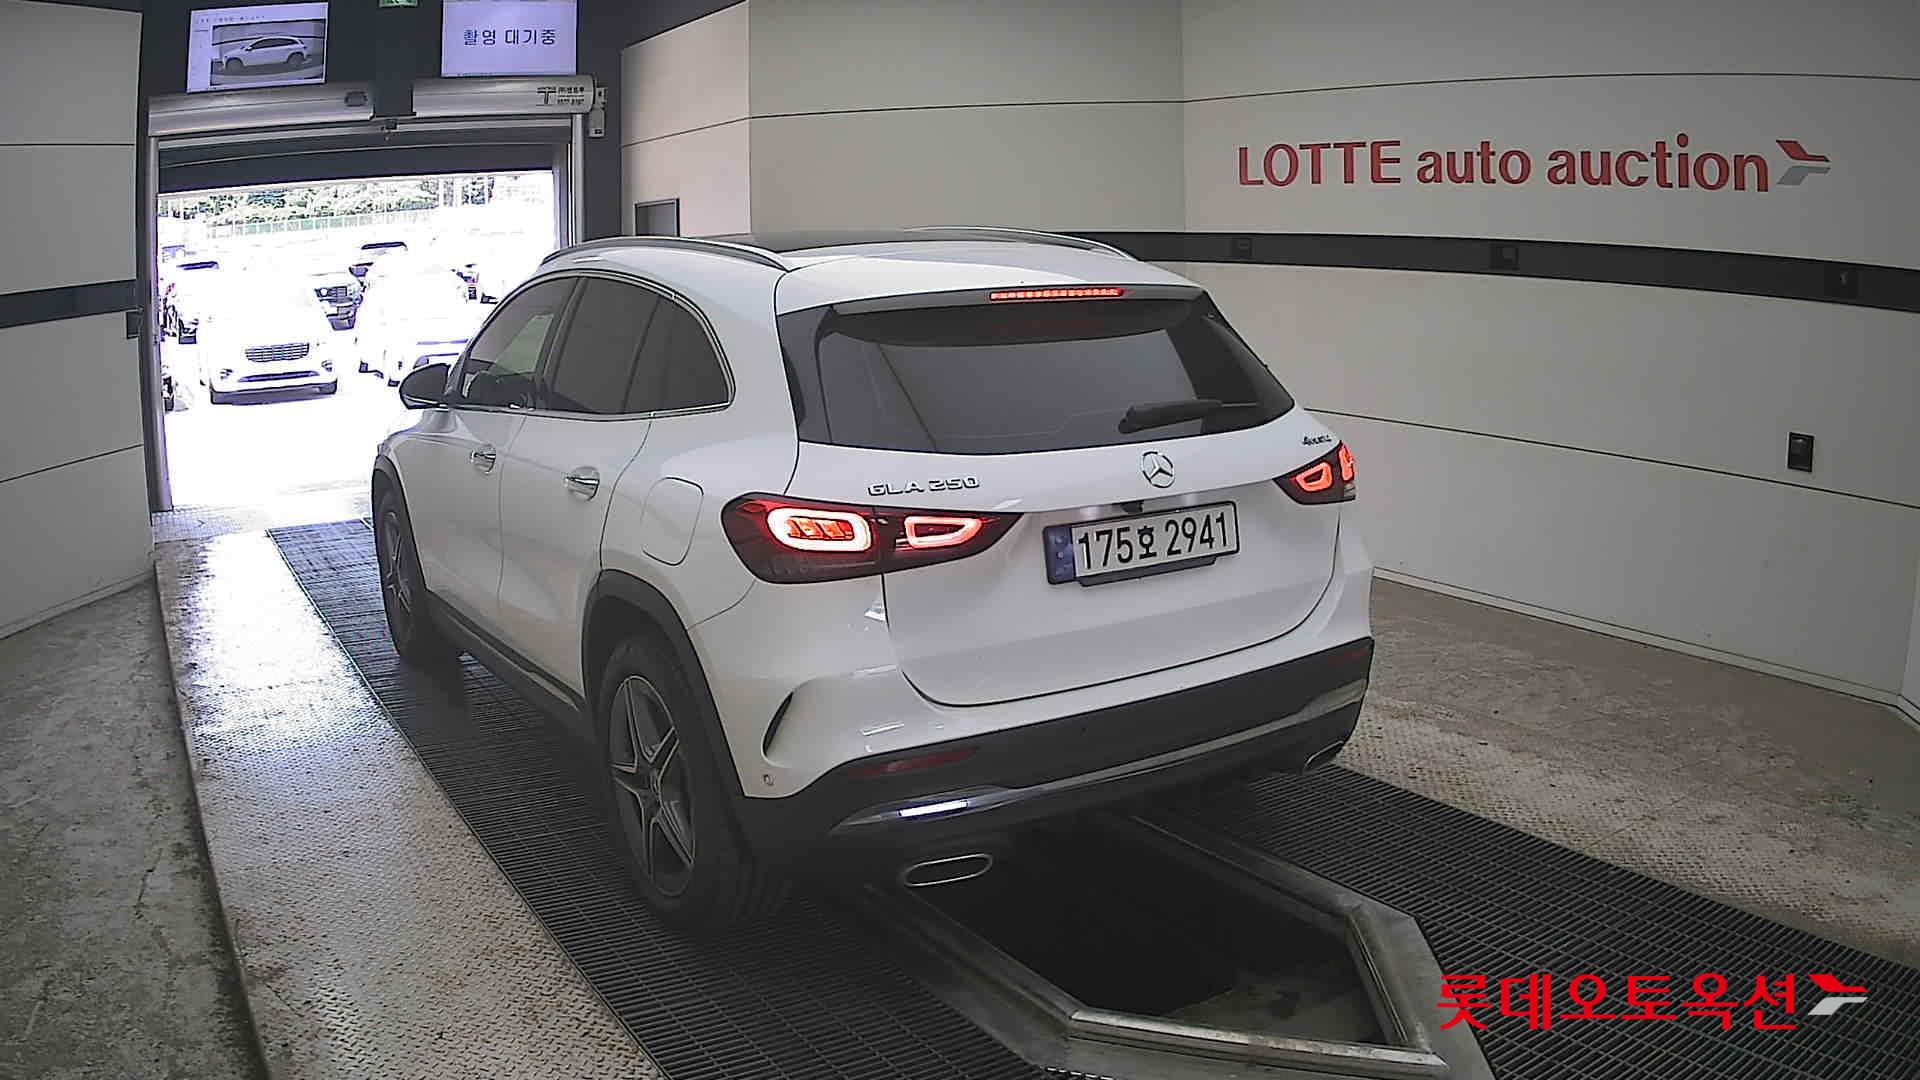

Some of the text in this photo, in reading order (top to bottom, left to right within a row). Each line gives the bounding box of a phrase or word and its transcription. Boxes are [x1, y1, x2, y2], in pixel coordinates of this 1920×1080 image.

[463, 29, 556, 46] 촬영 대기중
[1238, 132, 1769, 193] LOTTE auto auction
[867, 476, 980, 497] GLA 250
[1077, 511, 1230, 570] 175호 2941
